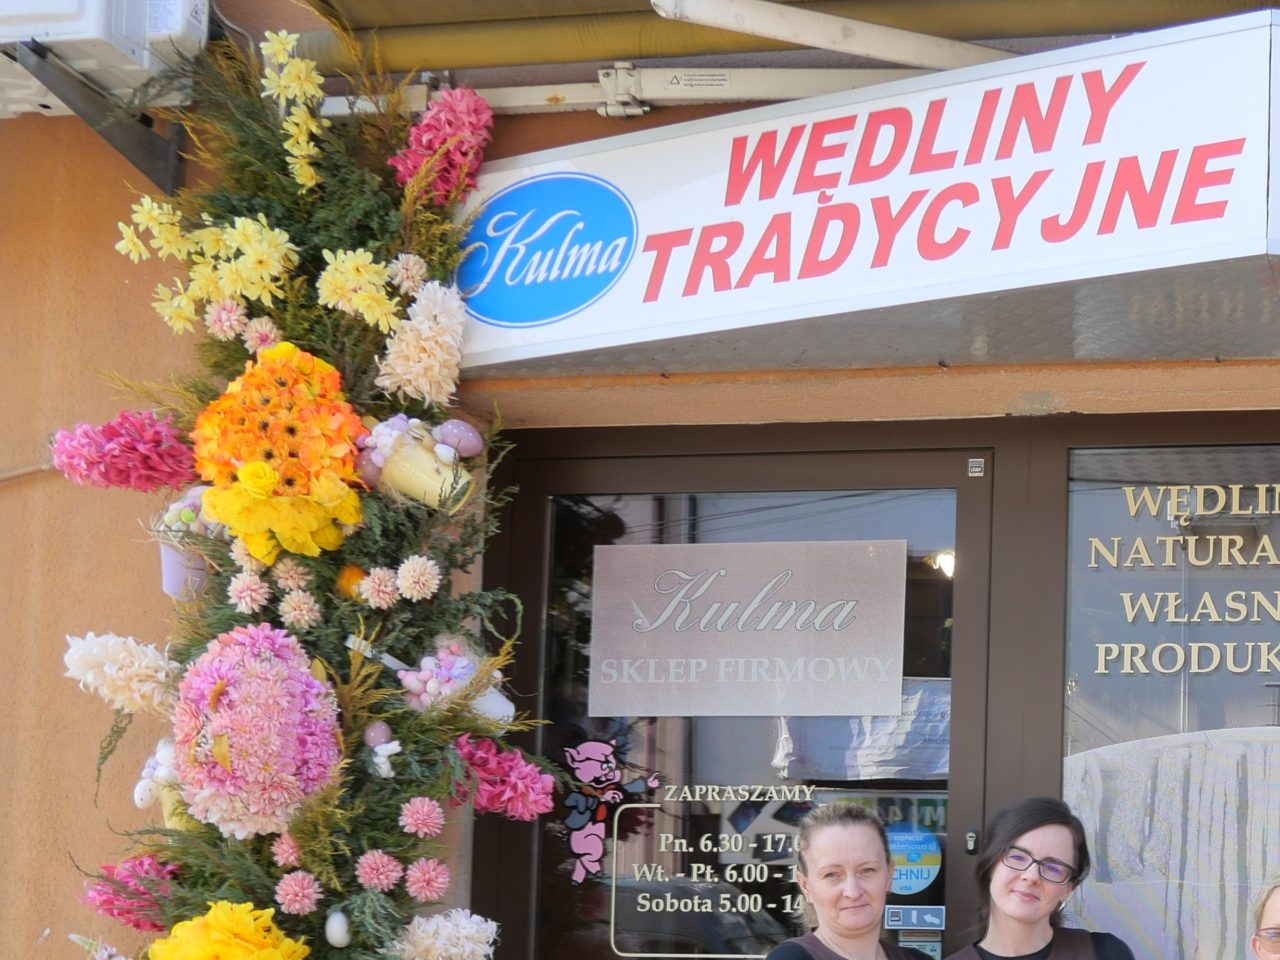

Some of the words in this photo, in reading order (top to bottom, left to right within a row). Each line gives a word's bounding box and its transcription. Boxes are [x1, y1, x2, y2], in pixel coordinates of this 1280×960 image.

[724, 60, 1147, 206] WĘDLINY
[642, 137, 1246, 304] TRADYCYJNE
[455, 208, 628, 298] Kulma
[632, 568, 861, 633] Kulma
[600, 658, 708, 684] SKLEP
[717, 656, 896, 683] FIRMOWY
[664, 785, 816, 802] ZAPRASZAMY
[659, 833, 694, 852] Pn.
[699, 833, 743, 852] 6.30
[632, 863, 670, 883] Wt.
[690, 863, 719, 883] Pt.
[725, 863, 768, 883] 6.00
[637, 892, 713, 913] Sobota
[718, 893, 762, 913] 5.00
